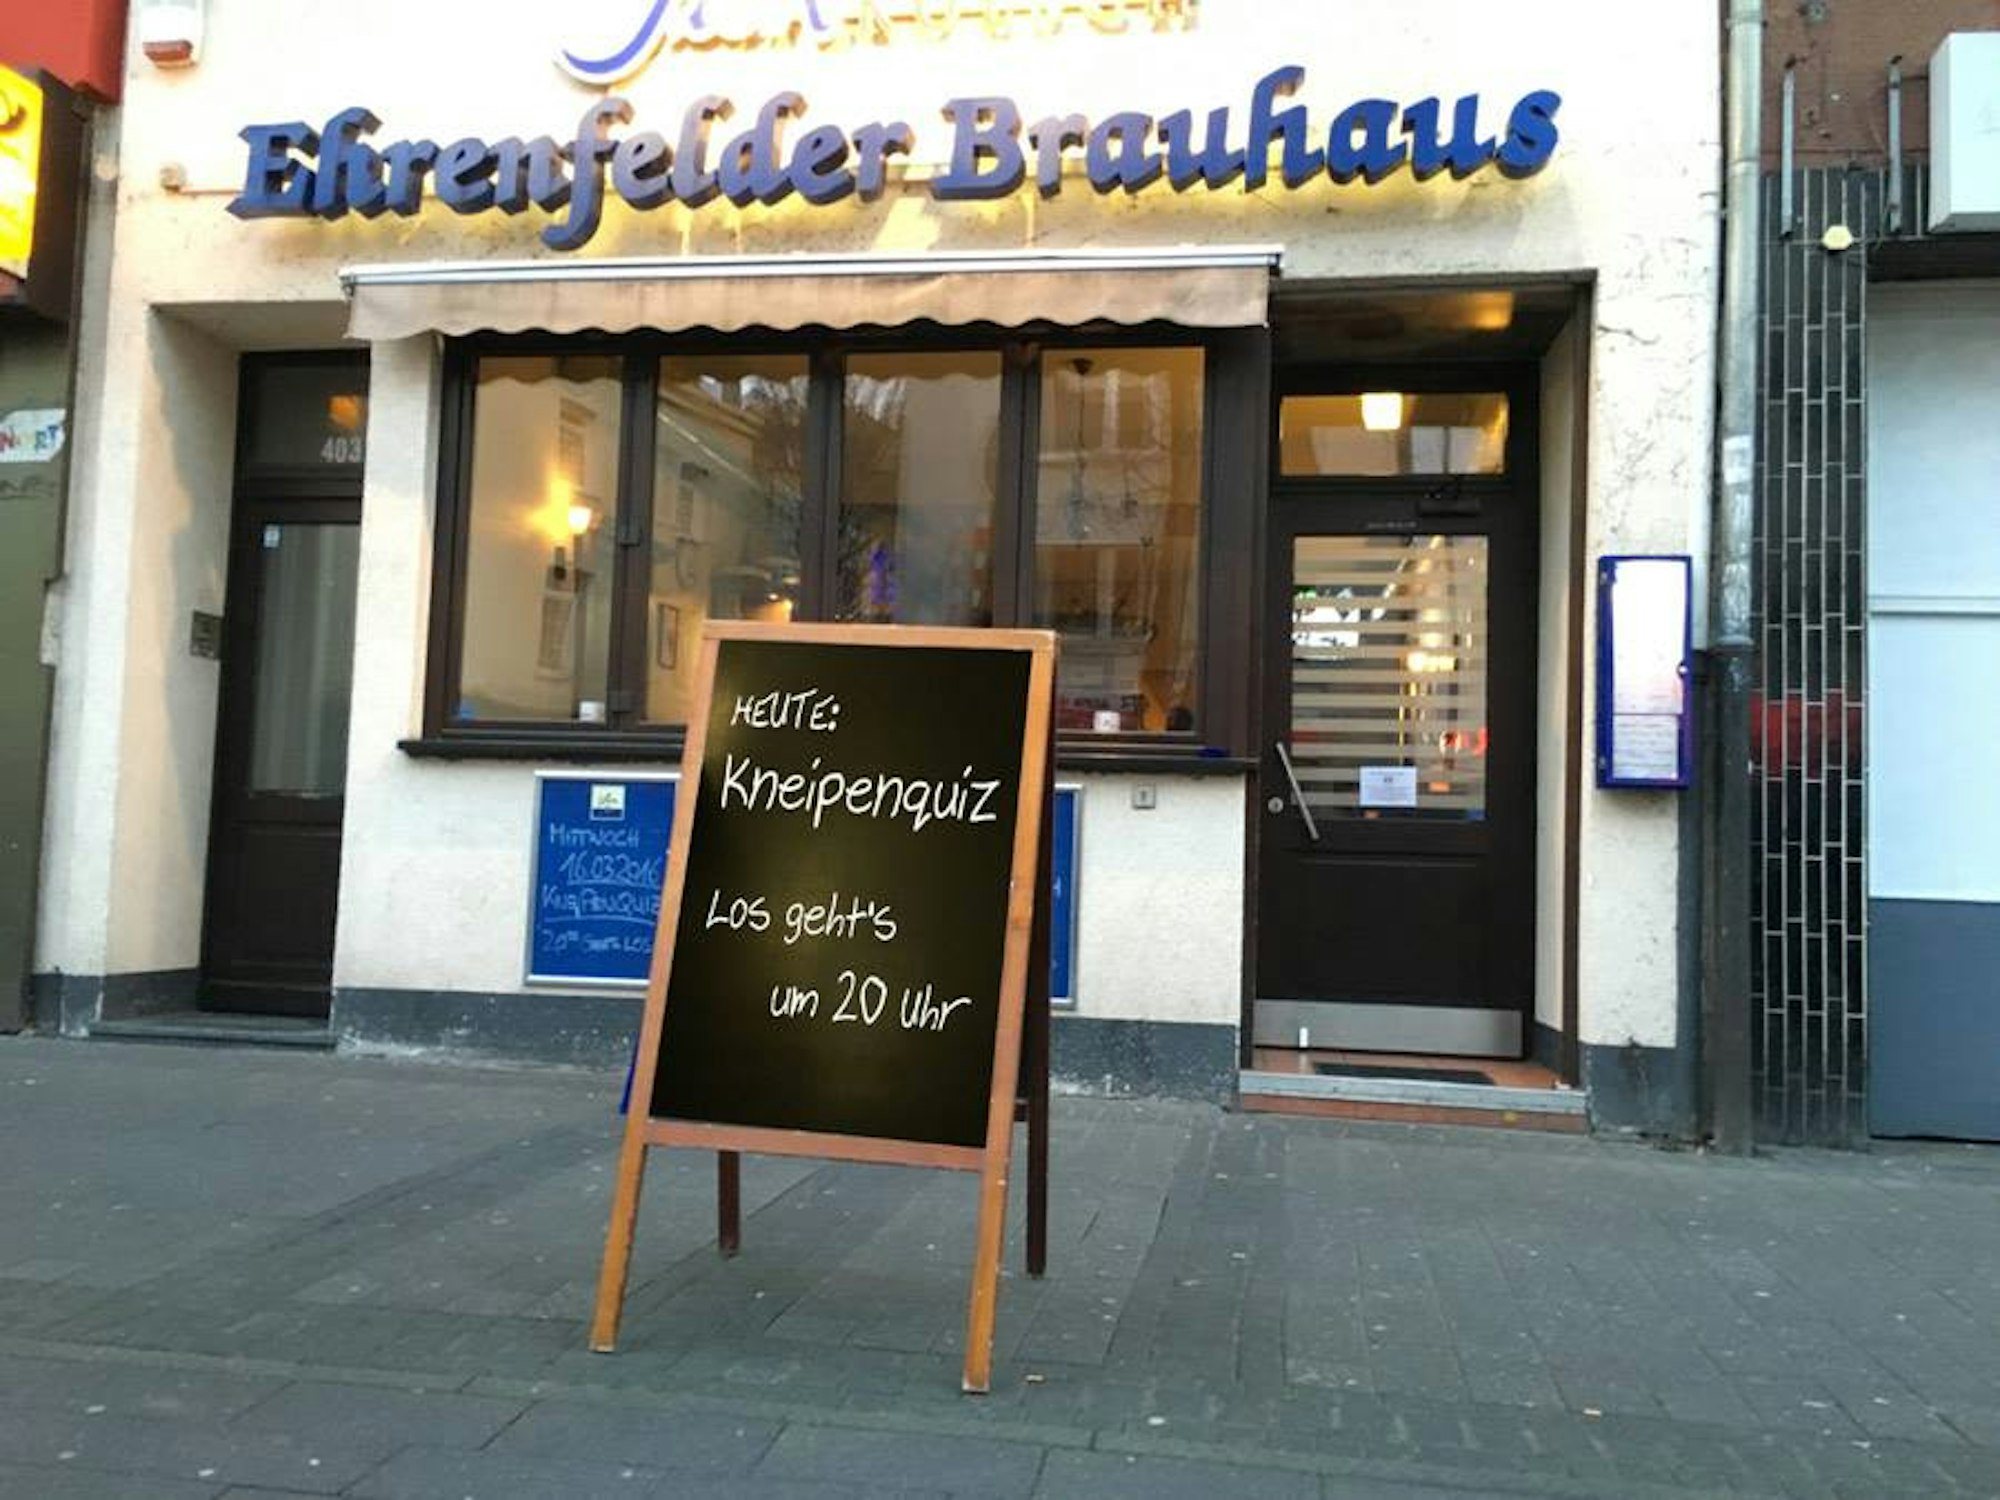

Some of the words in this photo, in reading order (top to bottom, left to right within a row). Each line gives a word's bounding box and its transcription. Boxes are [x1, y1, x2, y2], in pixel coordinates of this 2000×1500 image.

[226, 91, 916, 251] Ehrenfelder
[929, 64, 1562, 202] Brauhaus
[320, 436, 362, 464] 403
[729, 688, 841, 731] HEUTE:
[720, 752, 1001, 833] Kneipenquiz
[783, 891, 898, 946] geht's
[769, 985, 820, 1019] um
[831, 969, 889, 1026] 20
[900, 983, 973, 1032] Uhr
